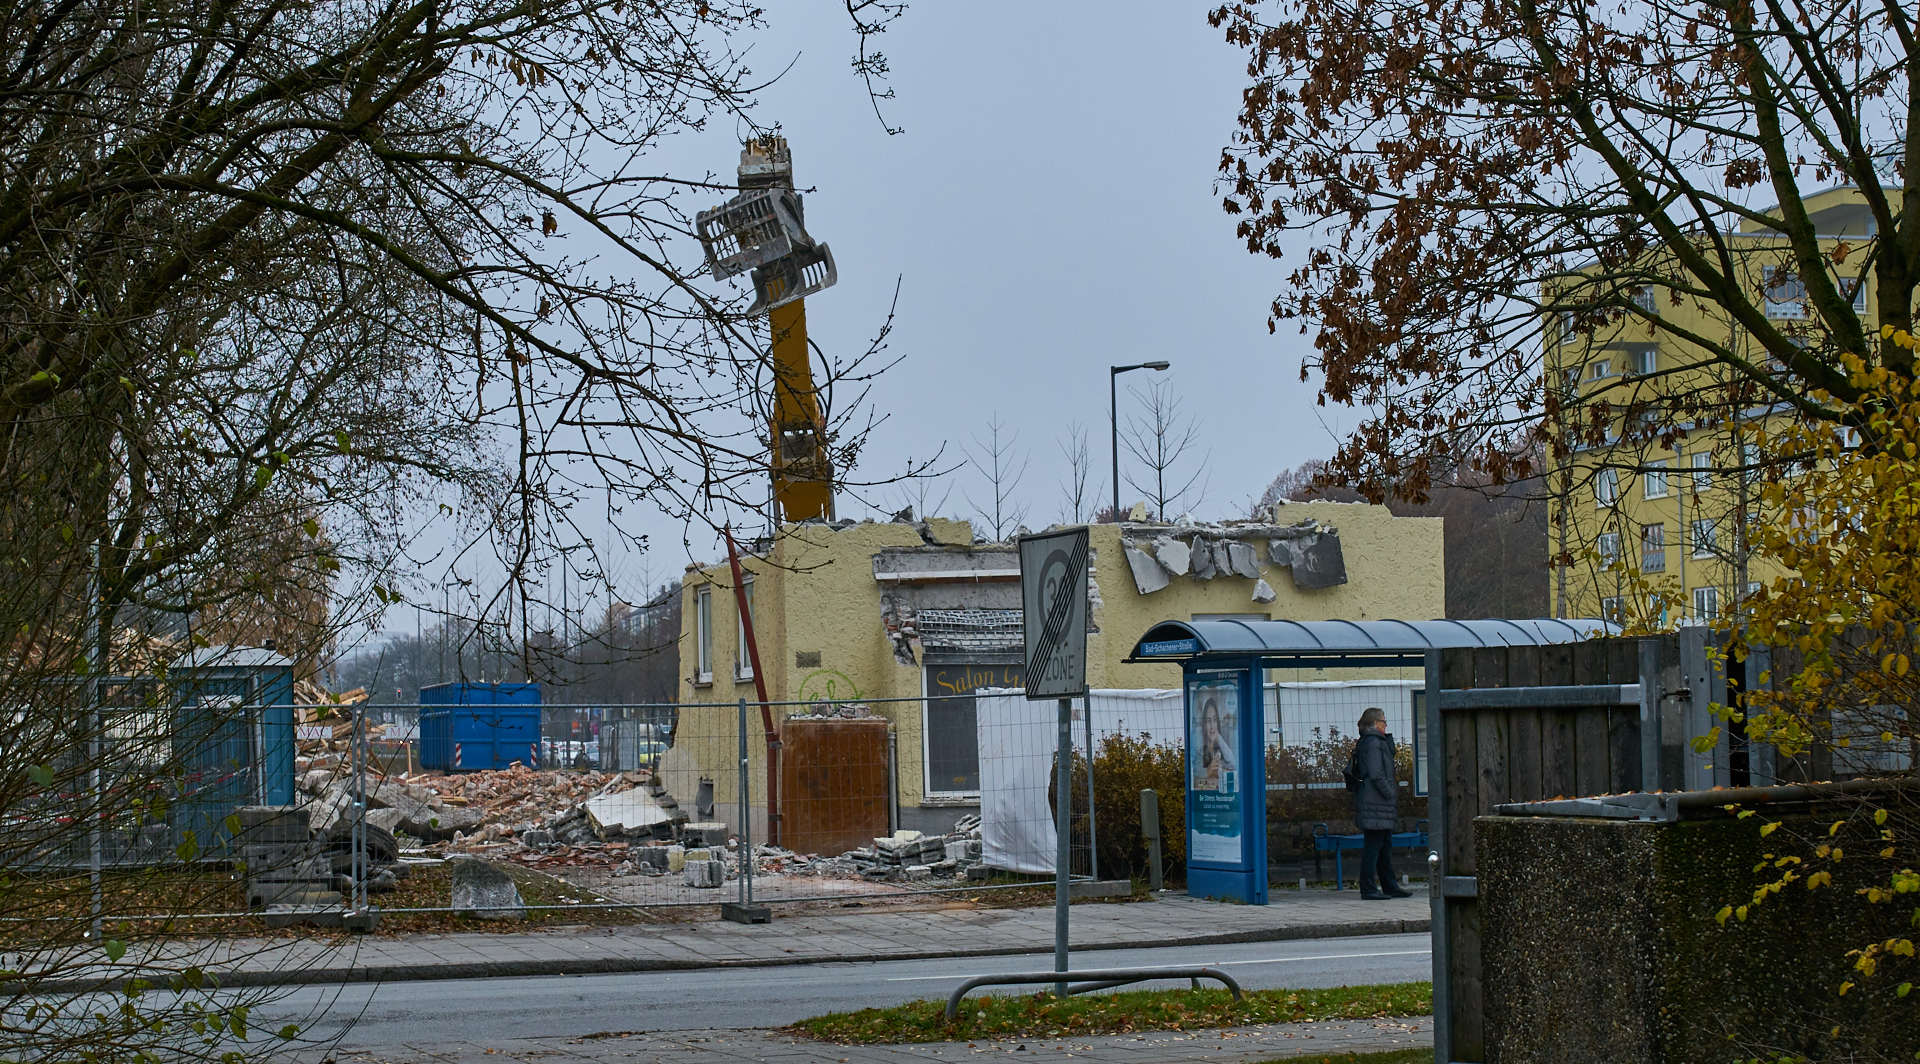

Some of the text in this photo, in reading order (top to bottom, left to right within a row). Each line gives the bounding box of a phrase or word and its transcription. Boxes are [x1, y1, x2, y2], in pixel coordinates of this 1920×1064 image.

[1145, 641, 1193, 653] Bad-Schachener-Straße
[1045, 655, 1075, 681] ZONE
[936, 664, 997, 701] Salon
[299, 726, 329, 738] MAC
[390, 726, 419, 738] MAC
